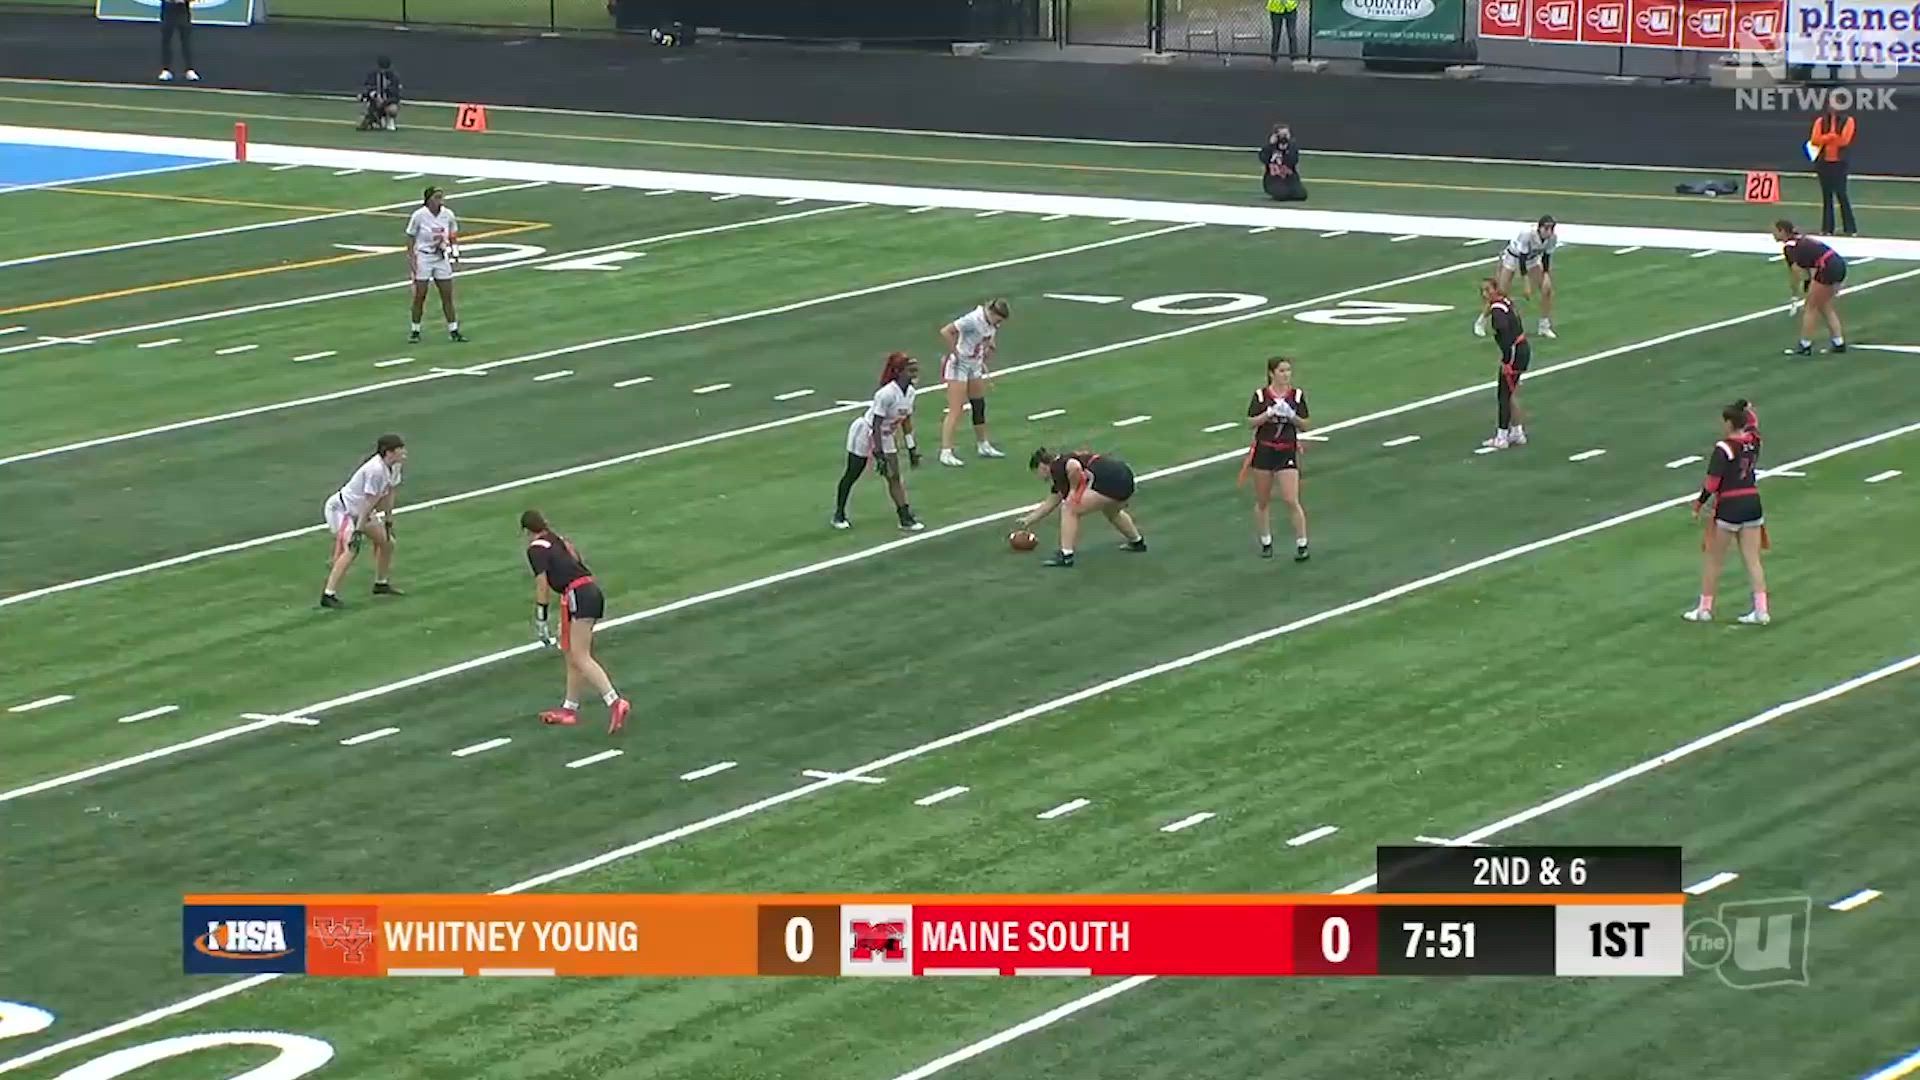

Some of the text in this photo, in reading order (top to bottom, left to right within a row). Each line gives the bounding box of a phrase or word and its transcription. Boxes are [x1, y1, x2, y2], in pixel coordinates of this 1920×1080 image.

[1353, 0, 1422, 11] COUNTRY
[462, 107, 477, 128] G
[1748, 177, 1773, 199] 20
